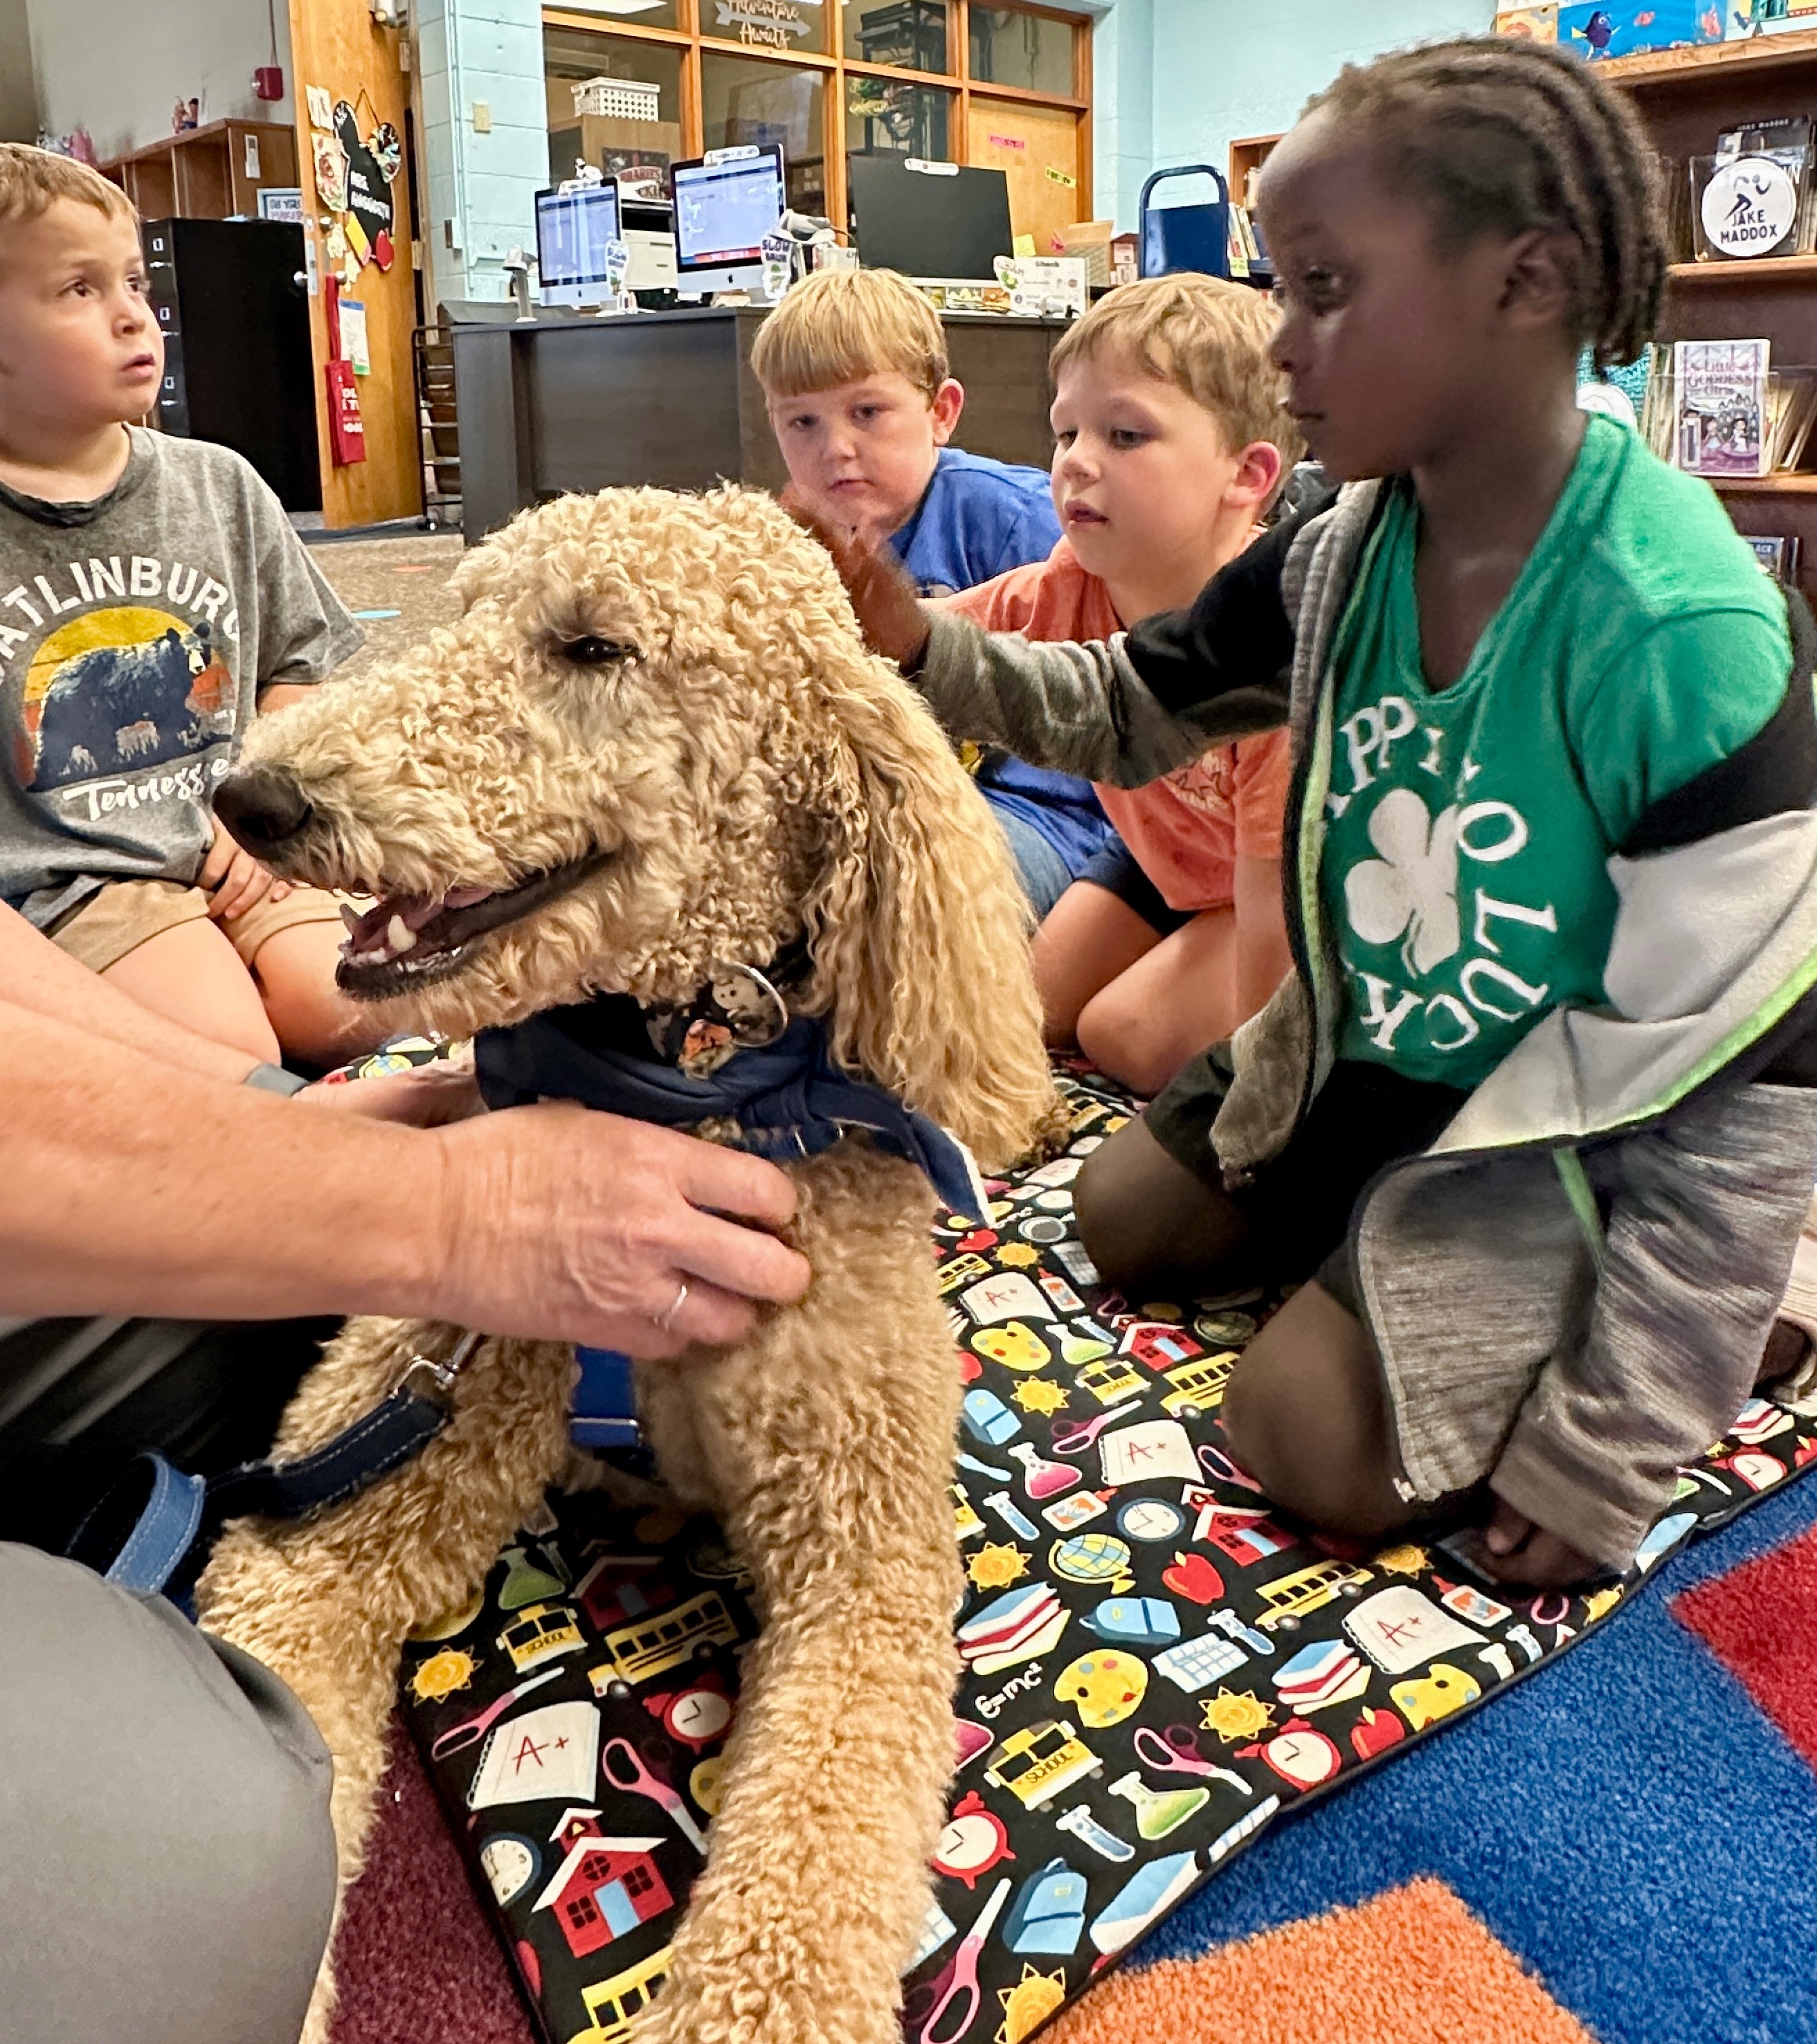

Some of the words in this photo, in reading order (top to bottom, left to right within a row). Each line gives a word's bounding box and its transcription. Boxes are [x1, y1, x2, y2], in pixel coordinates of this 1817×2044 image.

[740, 22, 790, 50] Awaits
[1733, 209, 1765, 226] JAKE
[1720, 224, 1778, 244] MADDOX
[0, 556, 239, 685] ATLINBURG
[1340, 887, 1558, 1051] LUCK
[526, 1631, 566, 1654] SCHOOL
[512, 1735, 570, 1777] A+
[1025, 1751, 1074, 1784] SCHOOL
